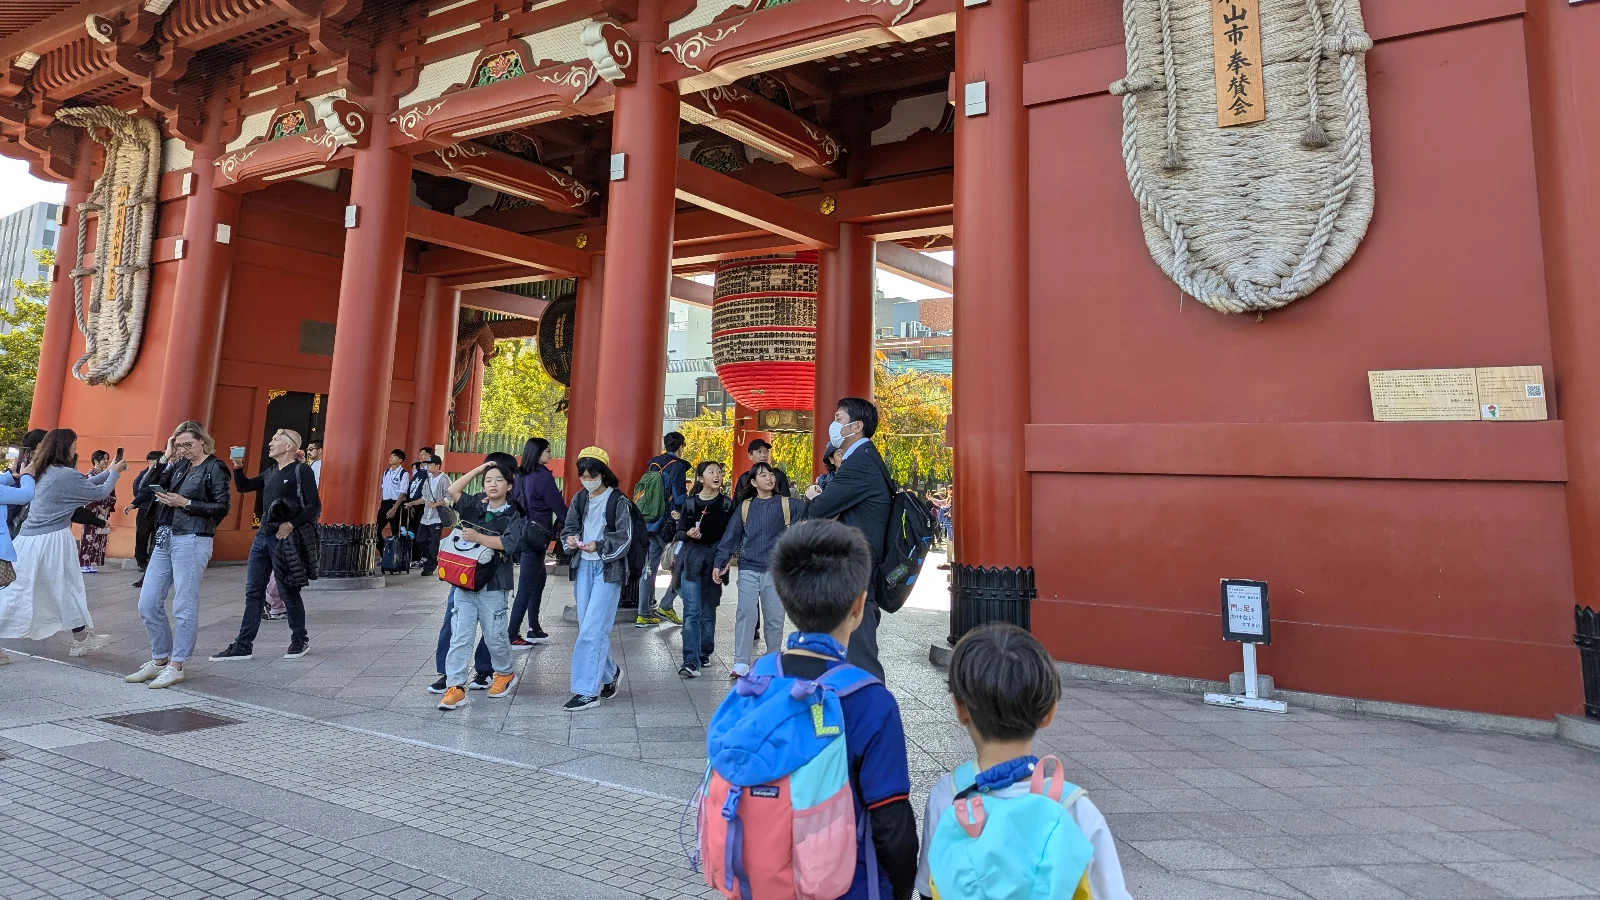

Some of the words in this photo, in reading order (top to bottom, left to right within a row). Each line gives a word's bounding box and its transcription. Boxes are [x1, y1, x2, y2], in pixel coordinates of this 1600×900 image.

[1218, 0, 1254, 116] 山市奉賛会
[811, 704, 840, 737] L
